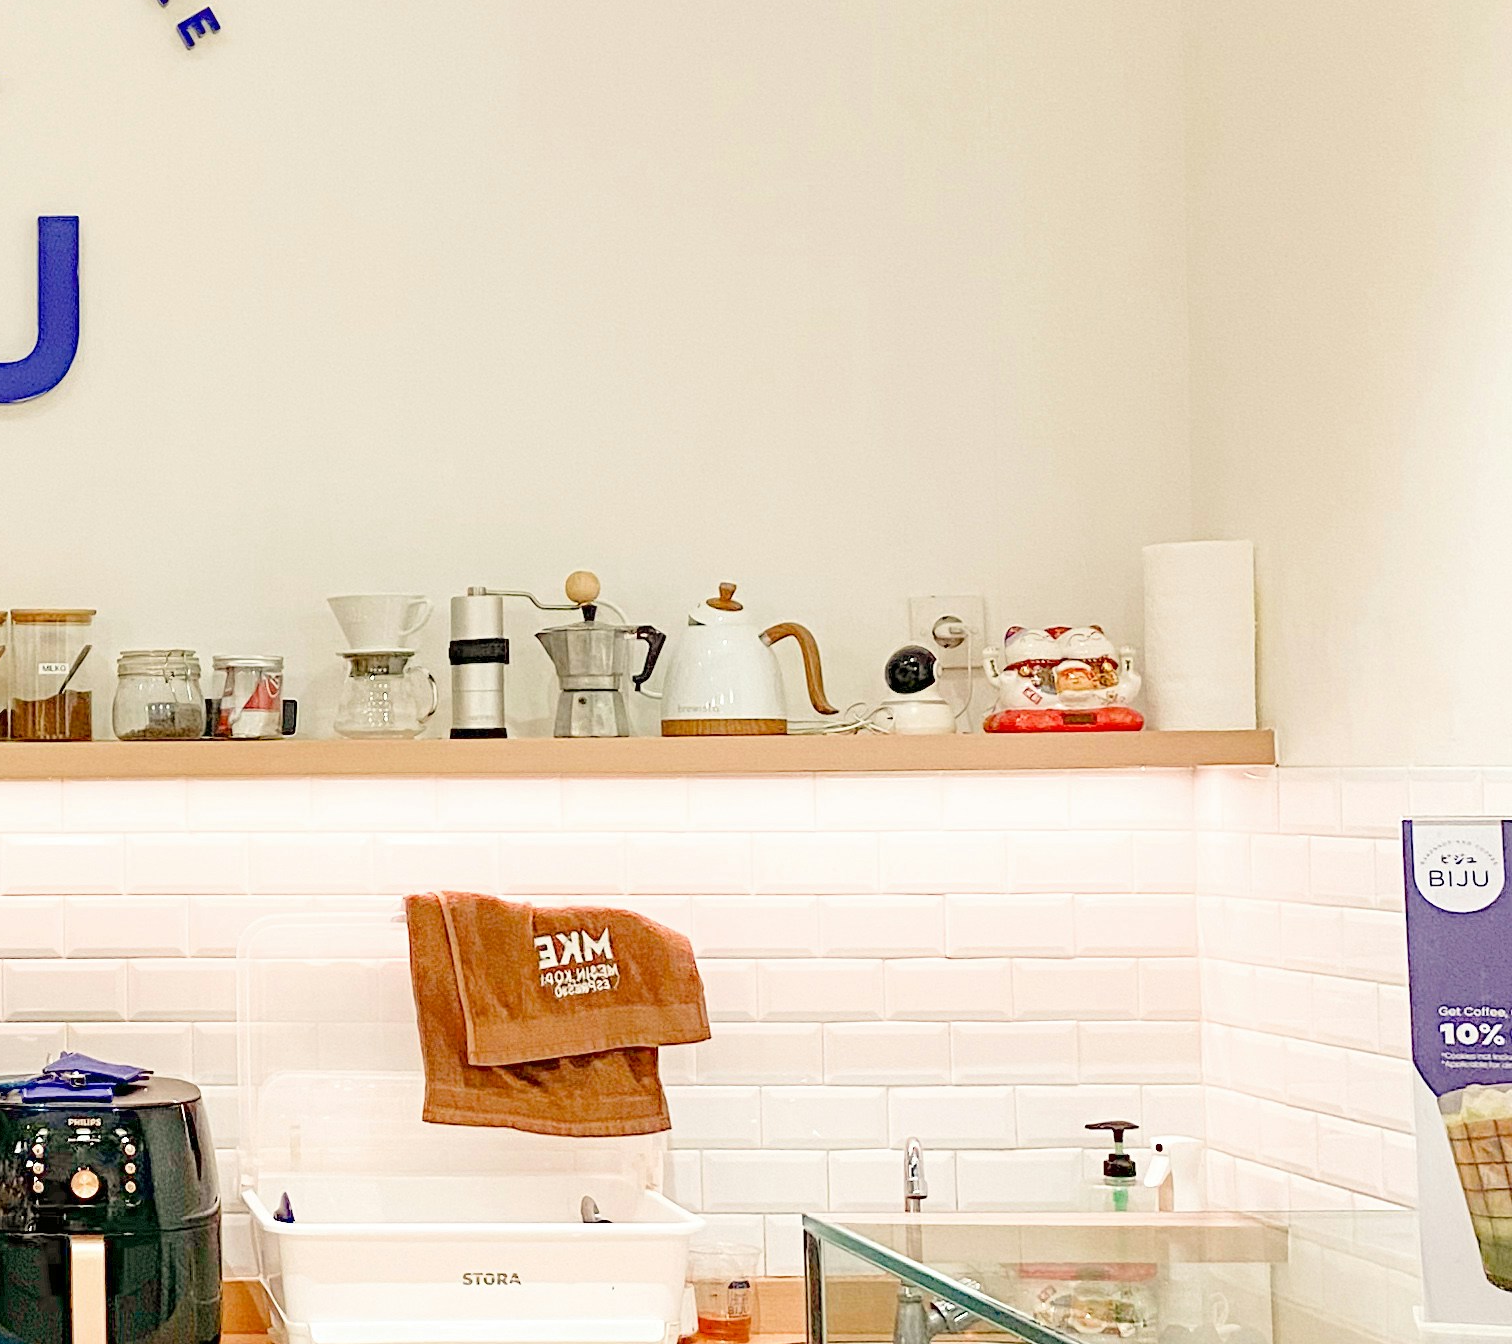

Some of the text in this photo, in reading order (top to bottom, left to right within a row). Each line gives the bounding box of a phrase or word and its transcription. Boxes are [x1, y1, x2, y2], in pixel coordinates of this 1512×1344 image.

[1429, 870, 1489, 887] BIJU
[1438, 1006, 1462, 1017] Get
[1439, 1022, 1506, 1046] 10%
[68, 1118, 102, 1126] PHILIPS
[462, 1272, 522, 1286] STORA
